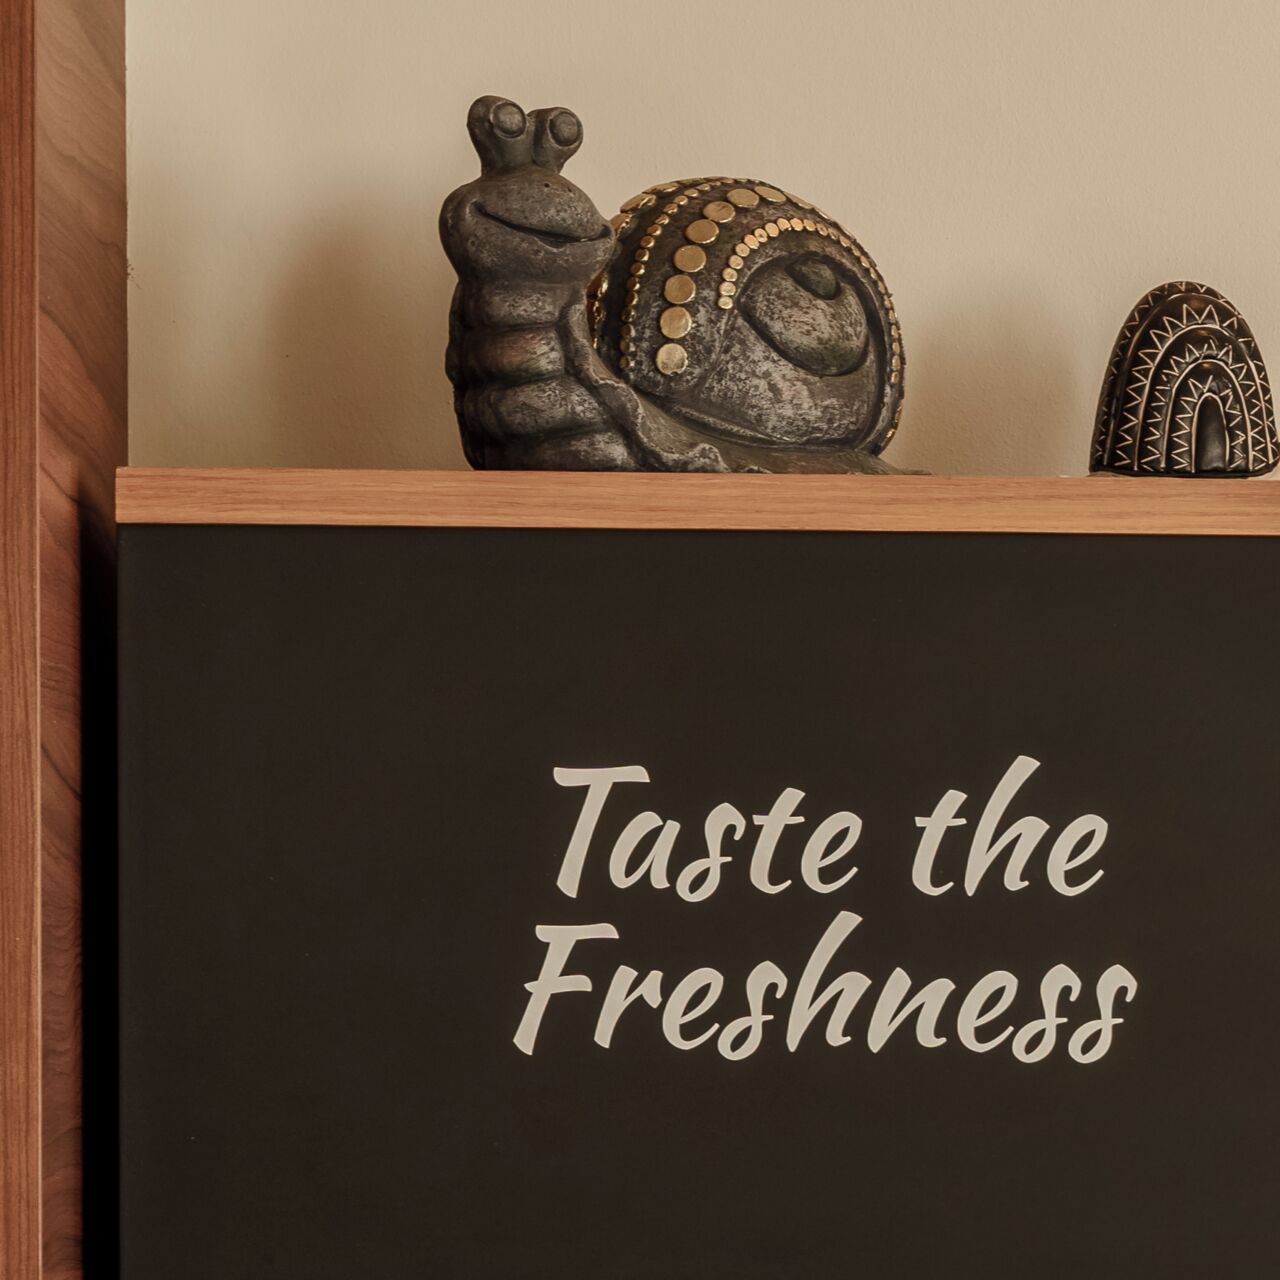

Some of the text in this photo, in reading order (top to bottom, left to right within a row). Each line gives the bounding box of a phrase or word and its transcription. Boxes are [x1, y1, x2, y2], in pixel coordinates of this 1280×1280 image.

[554, 756, 1109, 903] Taste the
[513, 911, 1138, 1064] Freshness
